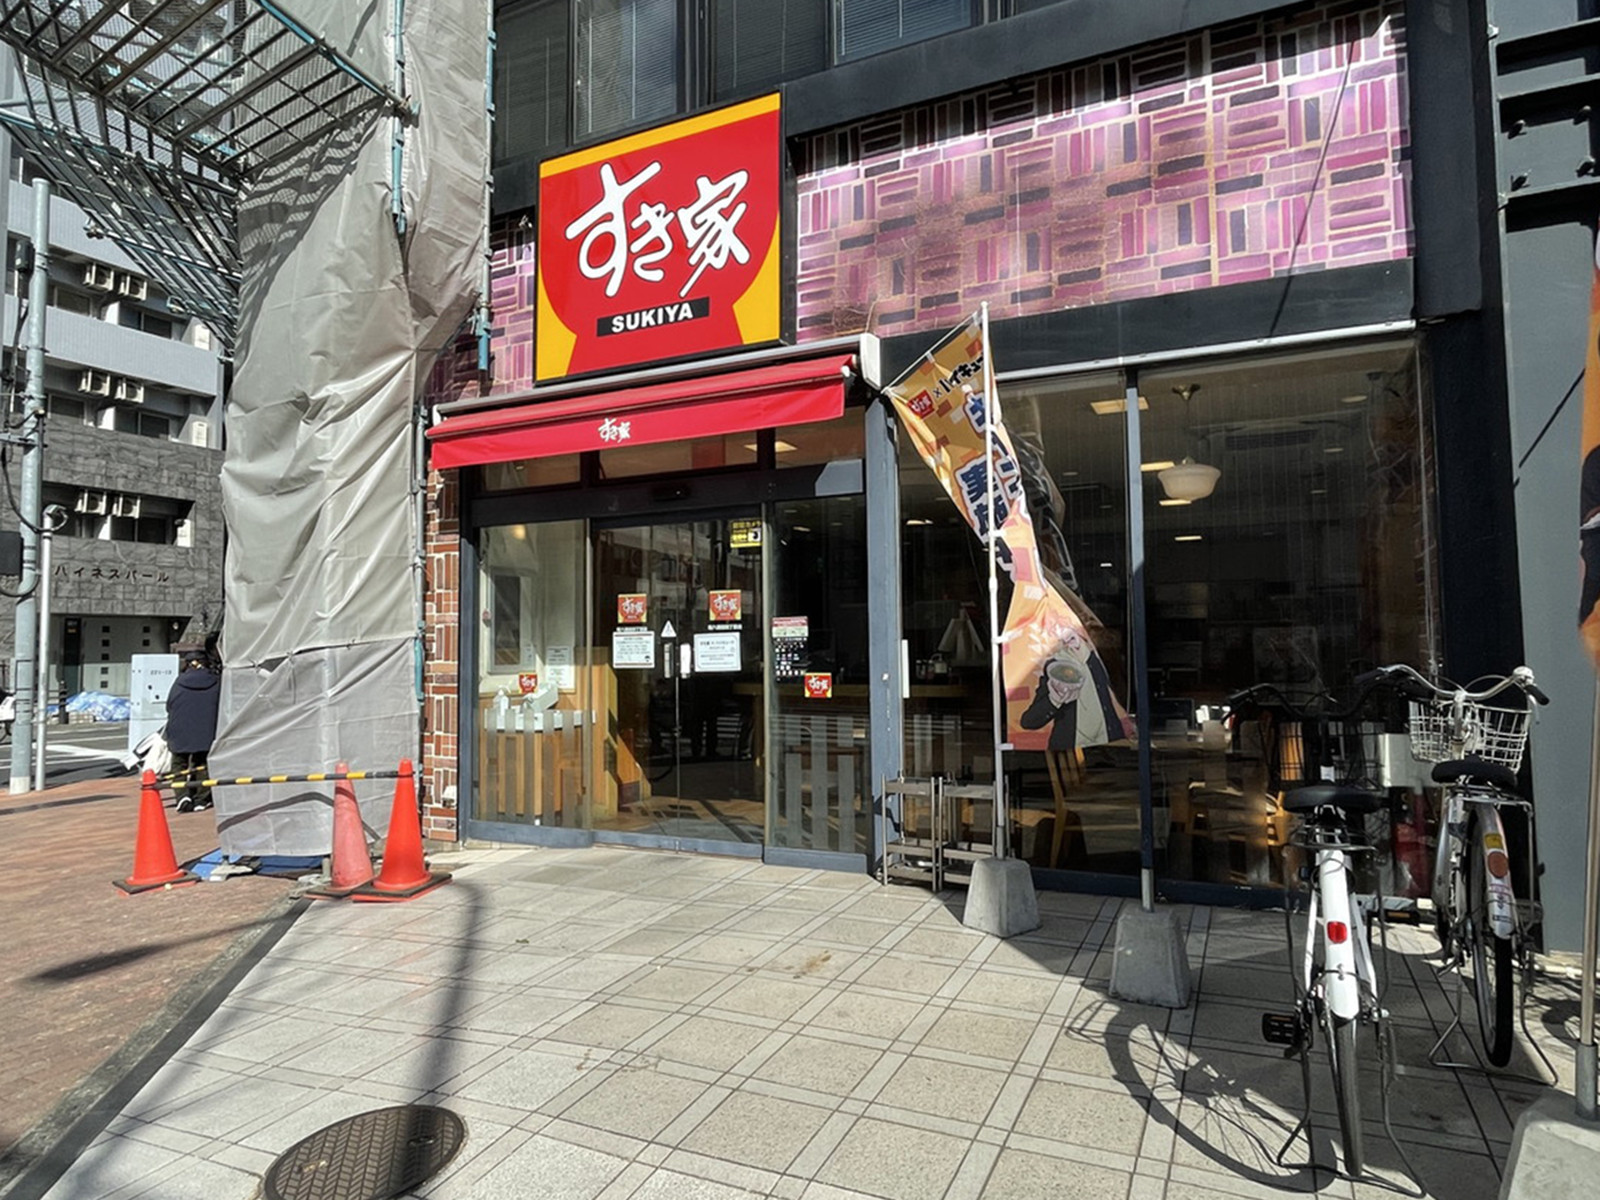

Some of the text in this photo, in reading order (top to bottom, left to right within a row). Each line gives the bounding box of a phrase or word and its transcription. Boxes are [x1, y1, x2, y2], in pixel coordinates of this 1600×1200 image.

[564, 161, 751, 299] すき家
[611, 302, 693, 333] SUKIYA
[597, 417, 631, 443] すき家
